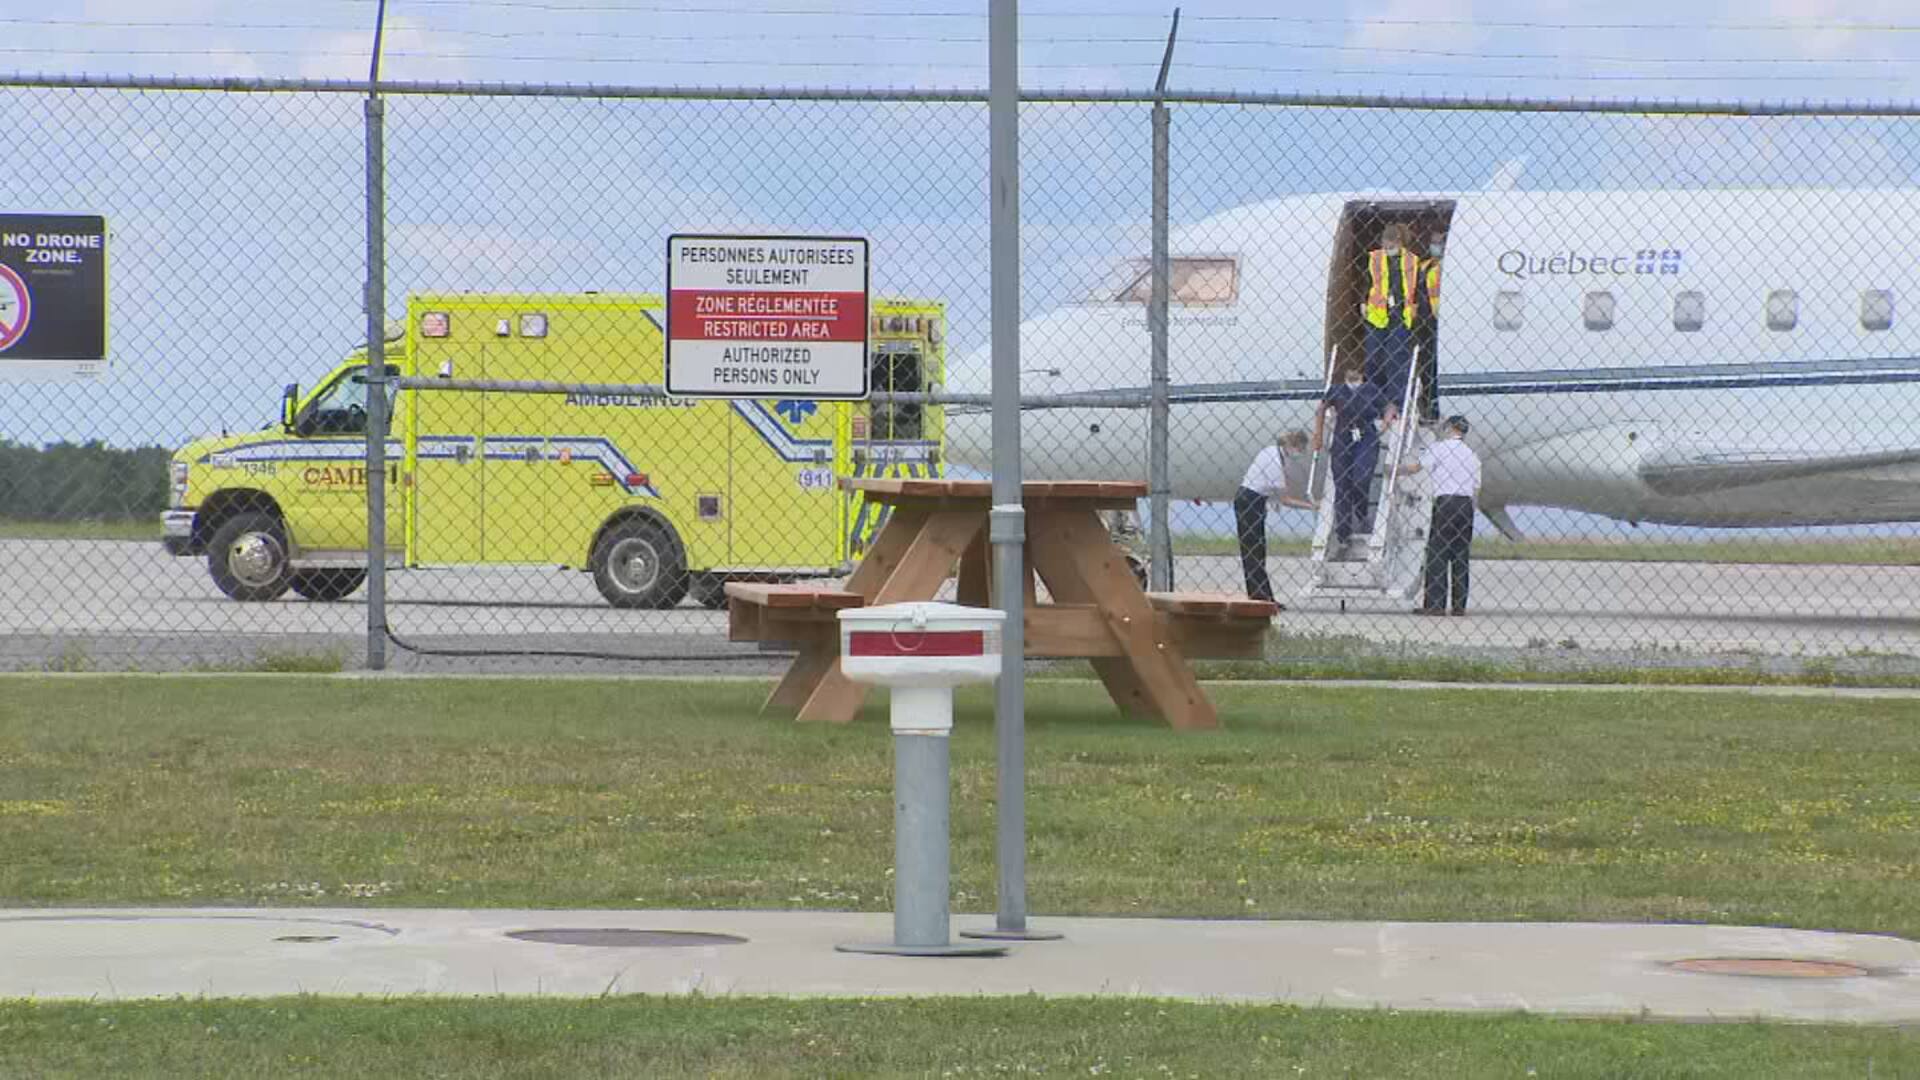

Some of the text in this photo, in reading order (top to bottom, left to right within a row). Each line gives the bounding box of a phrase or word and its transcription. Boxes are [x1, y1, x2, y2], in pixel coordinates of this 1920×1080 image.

[3, 233, 100, 248] NO DRONE
[26, 249, 83, 263] ZONE.
[681, 245, 854, 264] PERSONNES AUTORISÉES
[1498, 250, 1628, 280] Québec
[726, 269, 808, 285] SEULEMENT
[696, 294, 838, 315] ZONE RÉGLEMENTÉE
[704, 321, 830, 337] RESTRICTED AREA
[722, 348, 811, 364] AUTHORIZED
[714, 368, 820, 384] PERSONS ONLY
[804, 472, 831, 487] 911
